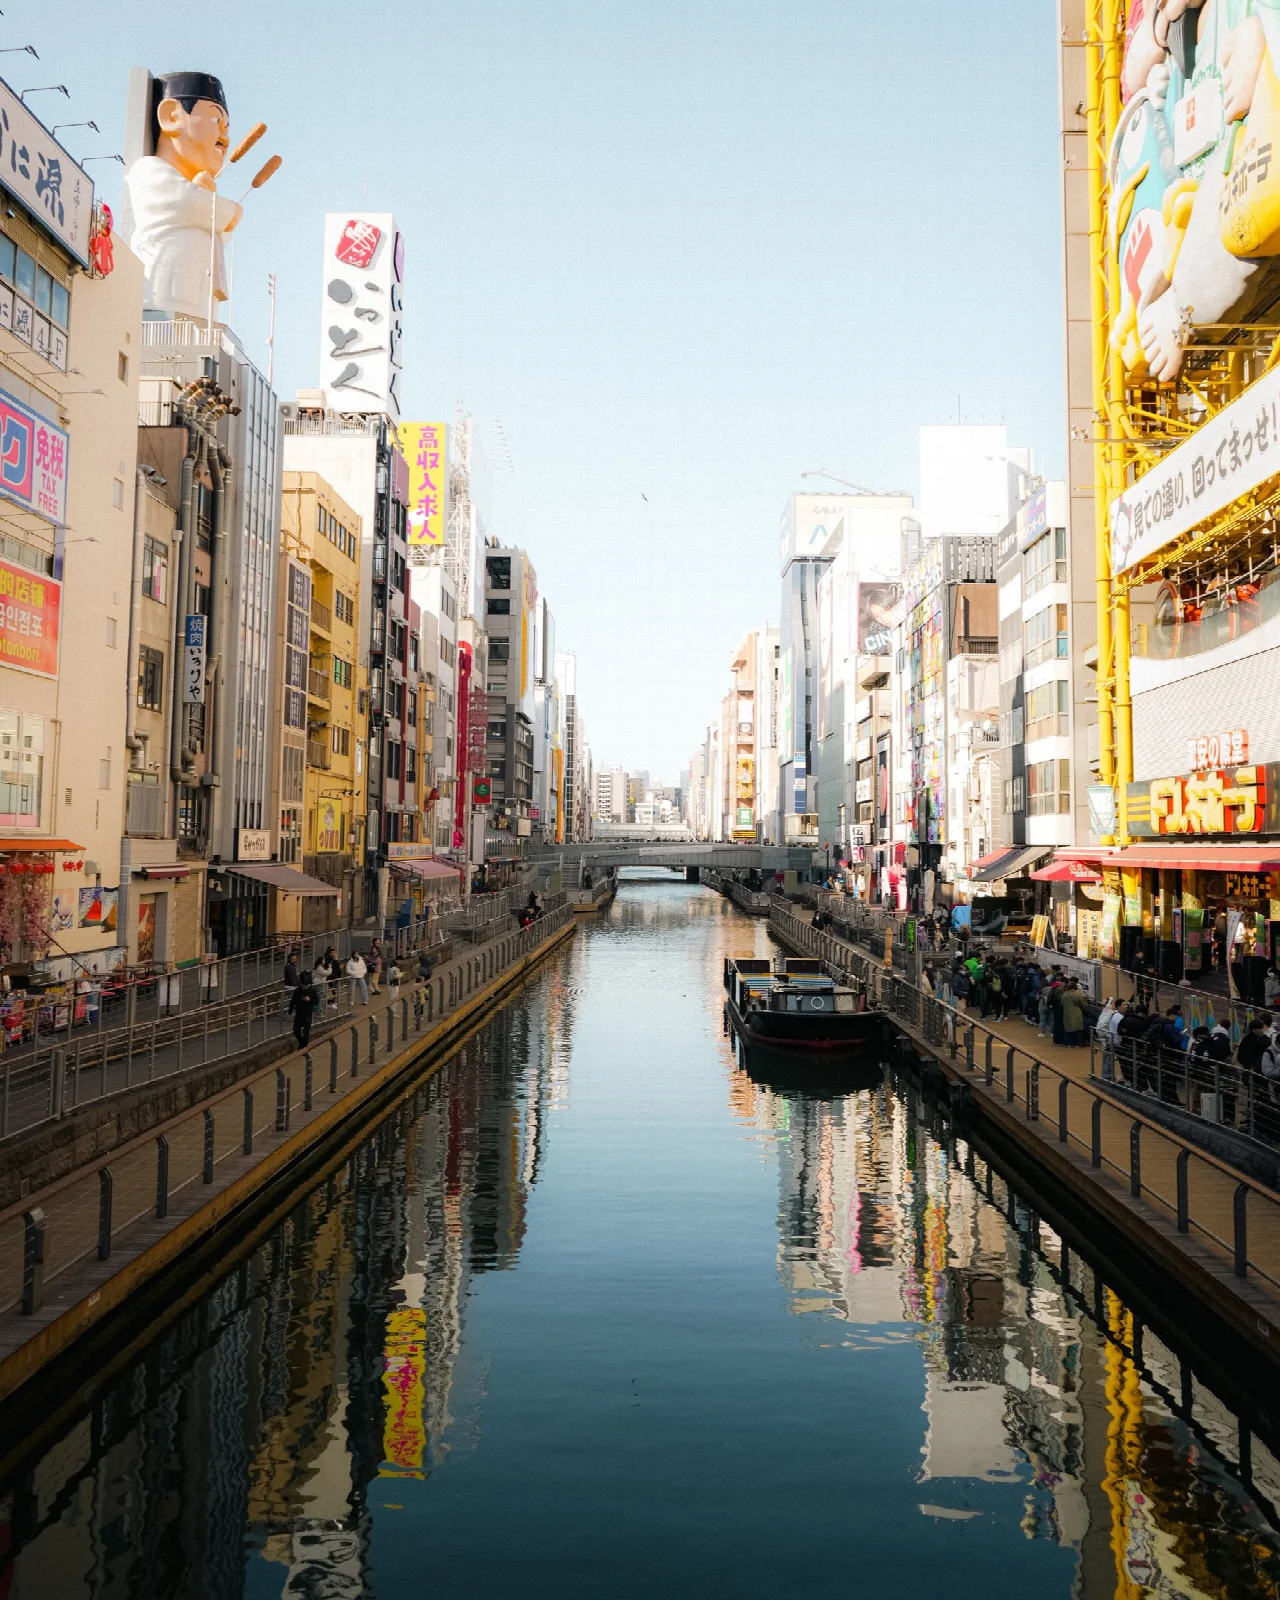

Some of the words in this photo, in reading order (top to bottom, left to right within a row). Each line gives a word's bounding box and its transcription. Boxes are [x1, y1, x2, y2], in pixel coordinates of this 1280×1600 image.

[35, 425, 63, 480] 免税
[38, 490, 58, 516] FREE
[41, 472, 57, 496] TAX
[416, 425, 440, 541] 高収入求人
[189, 617, 203, 645] 焼肉
[188, 647, 202, 701] いろりや
